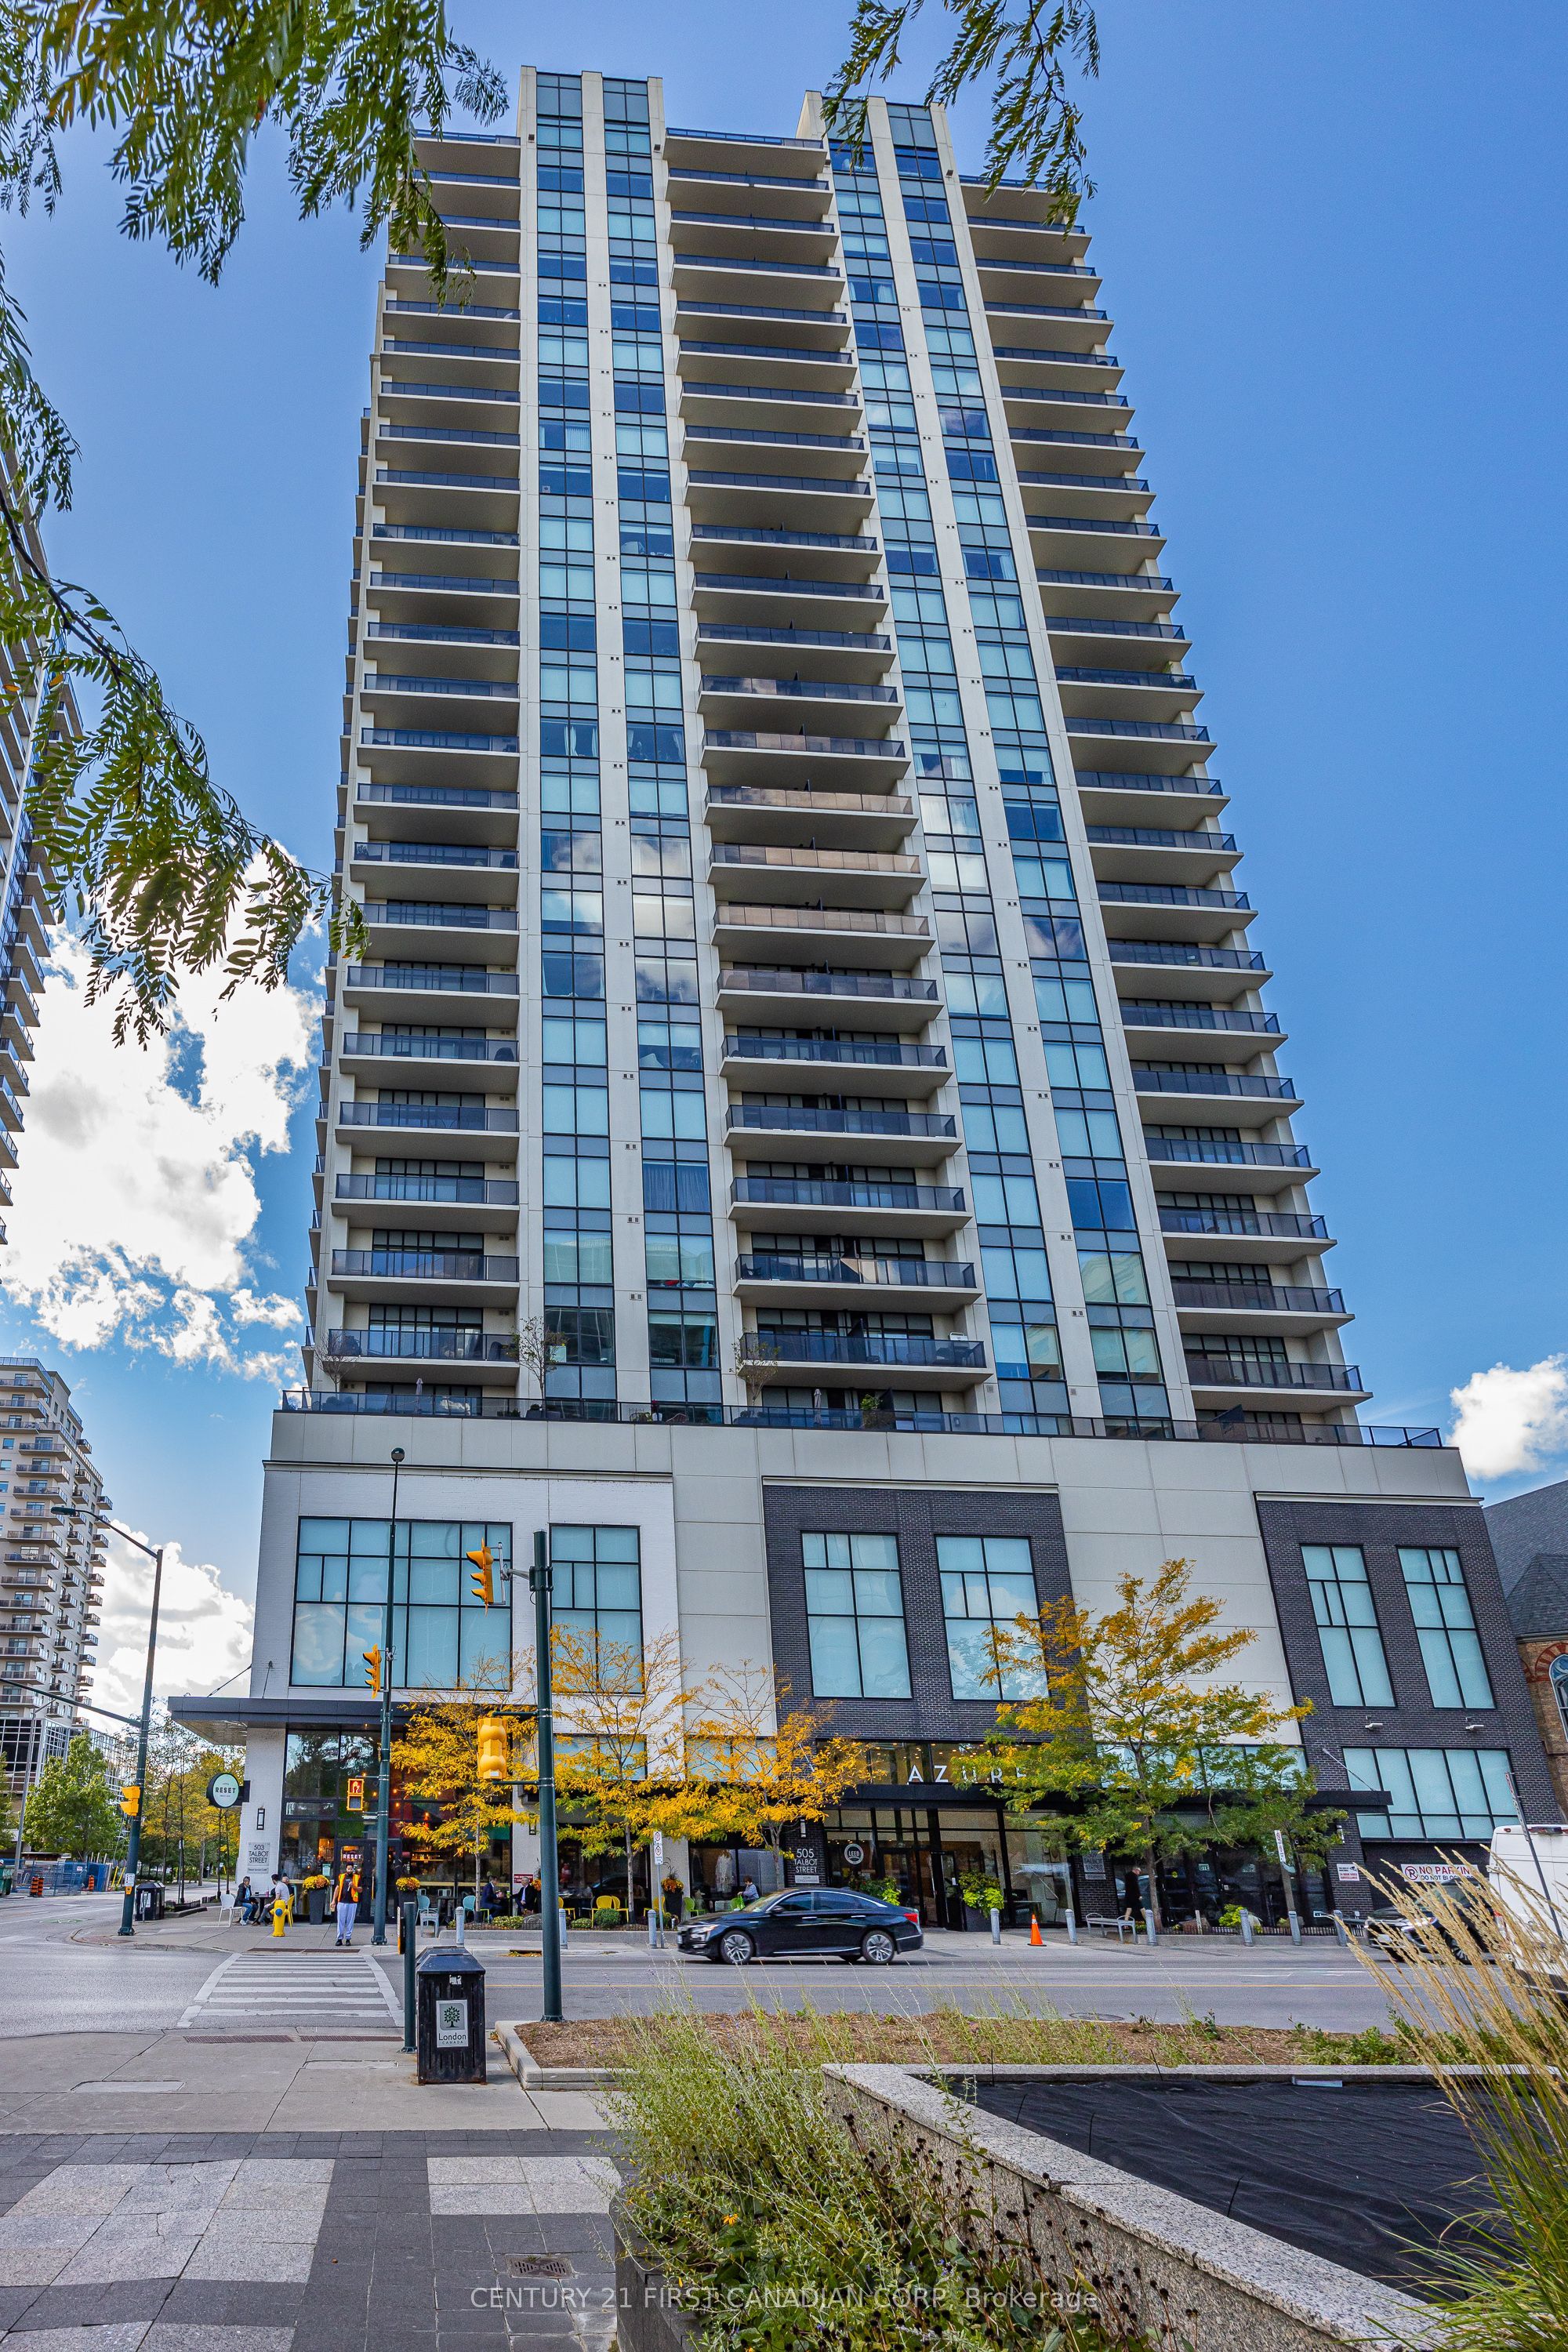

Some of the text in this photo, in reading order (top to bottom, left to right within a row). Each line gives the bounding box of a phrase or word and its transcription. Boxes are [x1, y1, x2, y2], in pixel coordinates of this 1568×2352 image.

[796, 1848, 815, 1858] 505
[1419, 1866, 1477, 1875] NO PARIN
[439, 2032, 466, 2041] London
